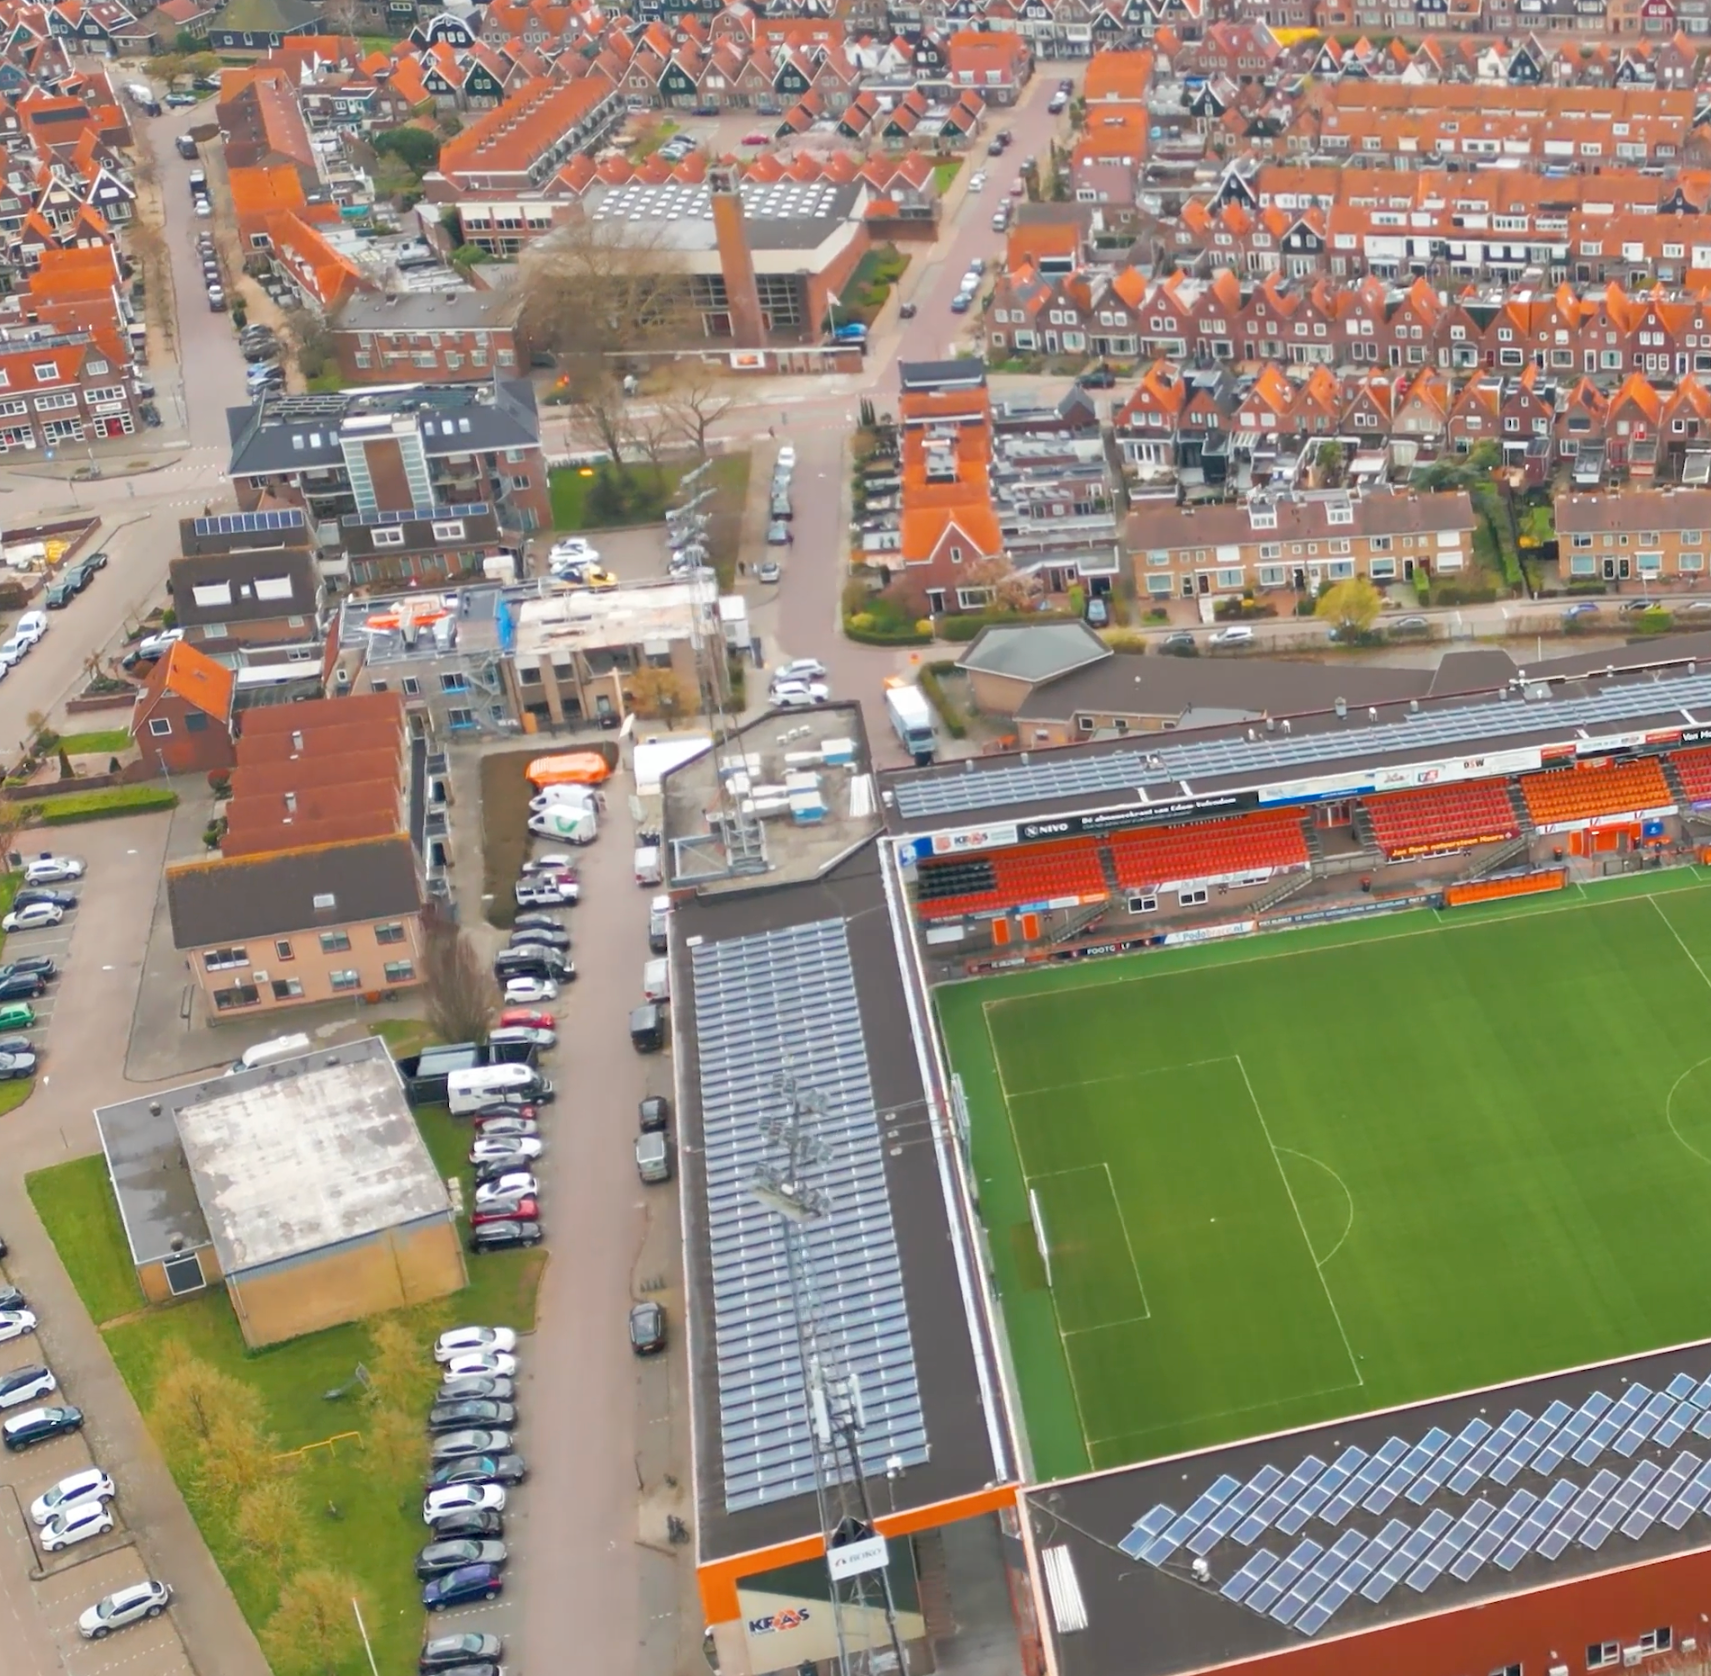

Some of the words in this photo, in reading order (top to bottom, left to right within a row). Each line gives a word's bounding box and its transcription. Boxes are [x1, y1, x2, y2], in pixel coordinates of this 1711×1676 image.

[1682, 733, 1699, 742] Van
[1154, 807, 1169, 816] van
[1039, 823, 1069, 834] NIVO
[1392, 847, 1407, 857] Jan
[1087, 942, 1131, 955] FOOTGLF
